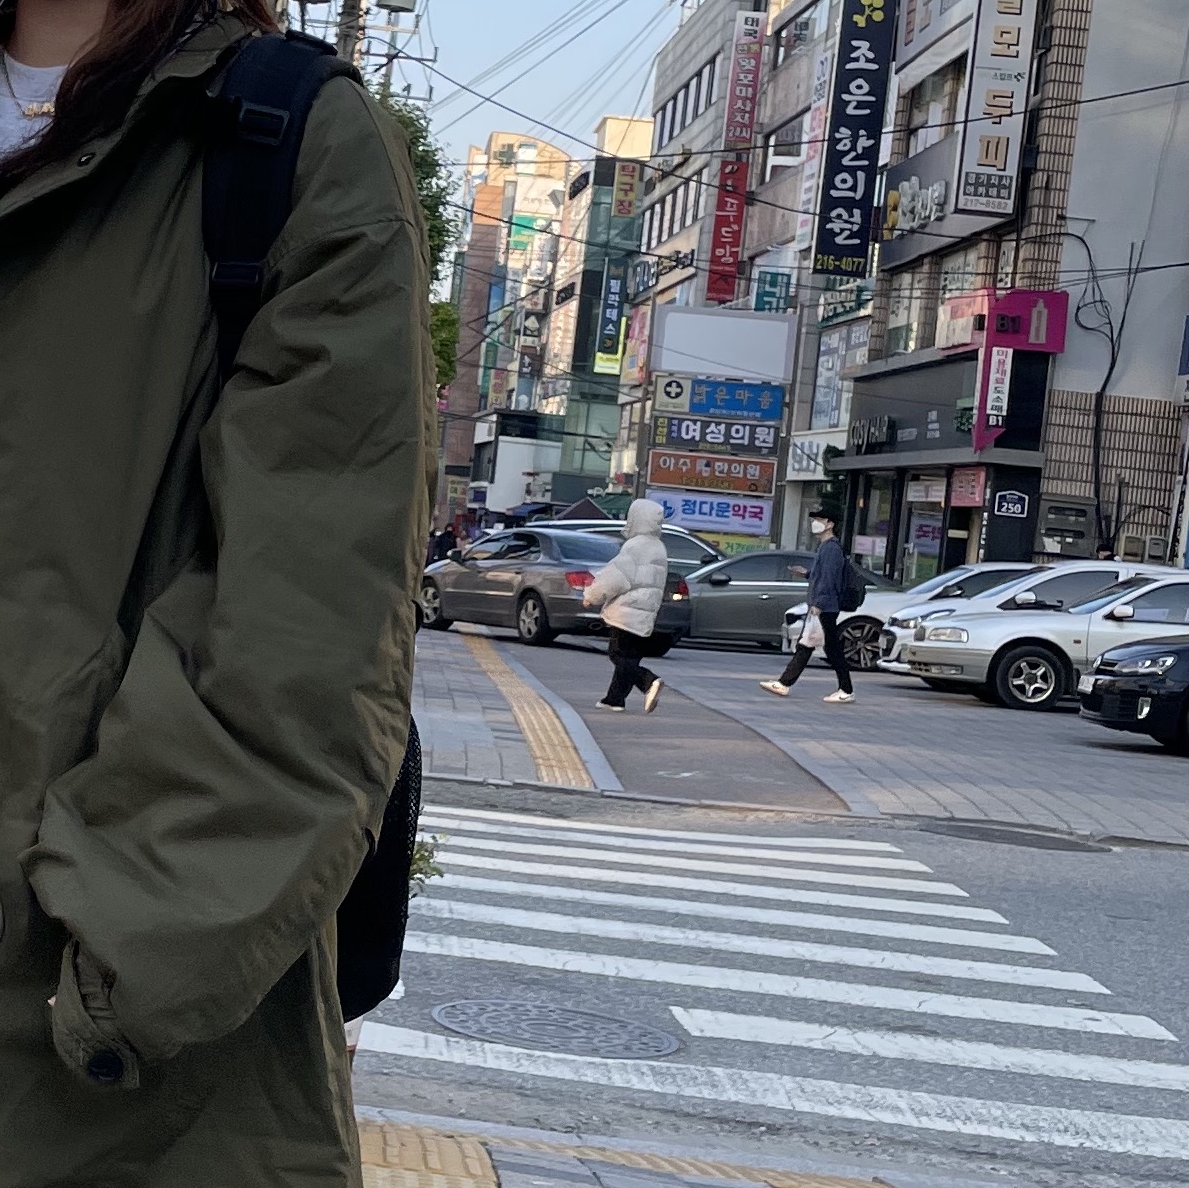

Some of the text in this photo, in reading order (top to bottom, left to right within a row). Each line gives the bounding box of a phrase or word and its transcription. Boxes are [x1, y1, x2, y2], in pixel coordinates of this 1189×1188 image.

[744, 16, 760, 39] 태국
[977, 89, 1016, 172] 두피
[826, 39, 879, 246] 조은한의원
[616, 164, 637, 216] 탁구장
[965, 185, 1009, 198] 아카데미
[996, 313, 1022, 333] B1
[990, 349, 1010, 414] 미용재료도소매
[988, 415, 1003, 426] B1
[680, 420, 775, 447] 여성의원
[659, 456, 691, 473] 아주
[681, 498, 764, 522] 정다운약국
[1001, 502, 1022, 514] 250
